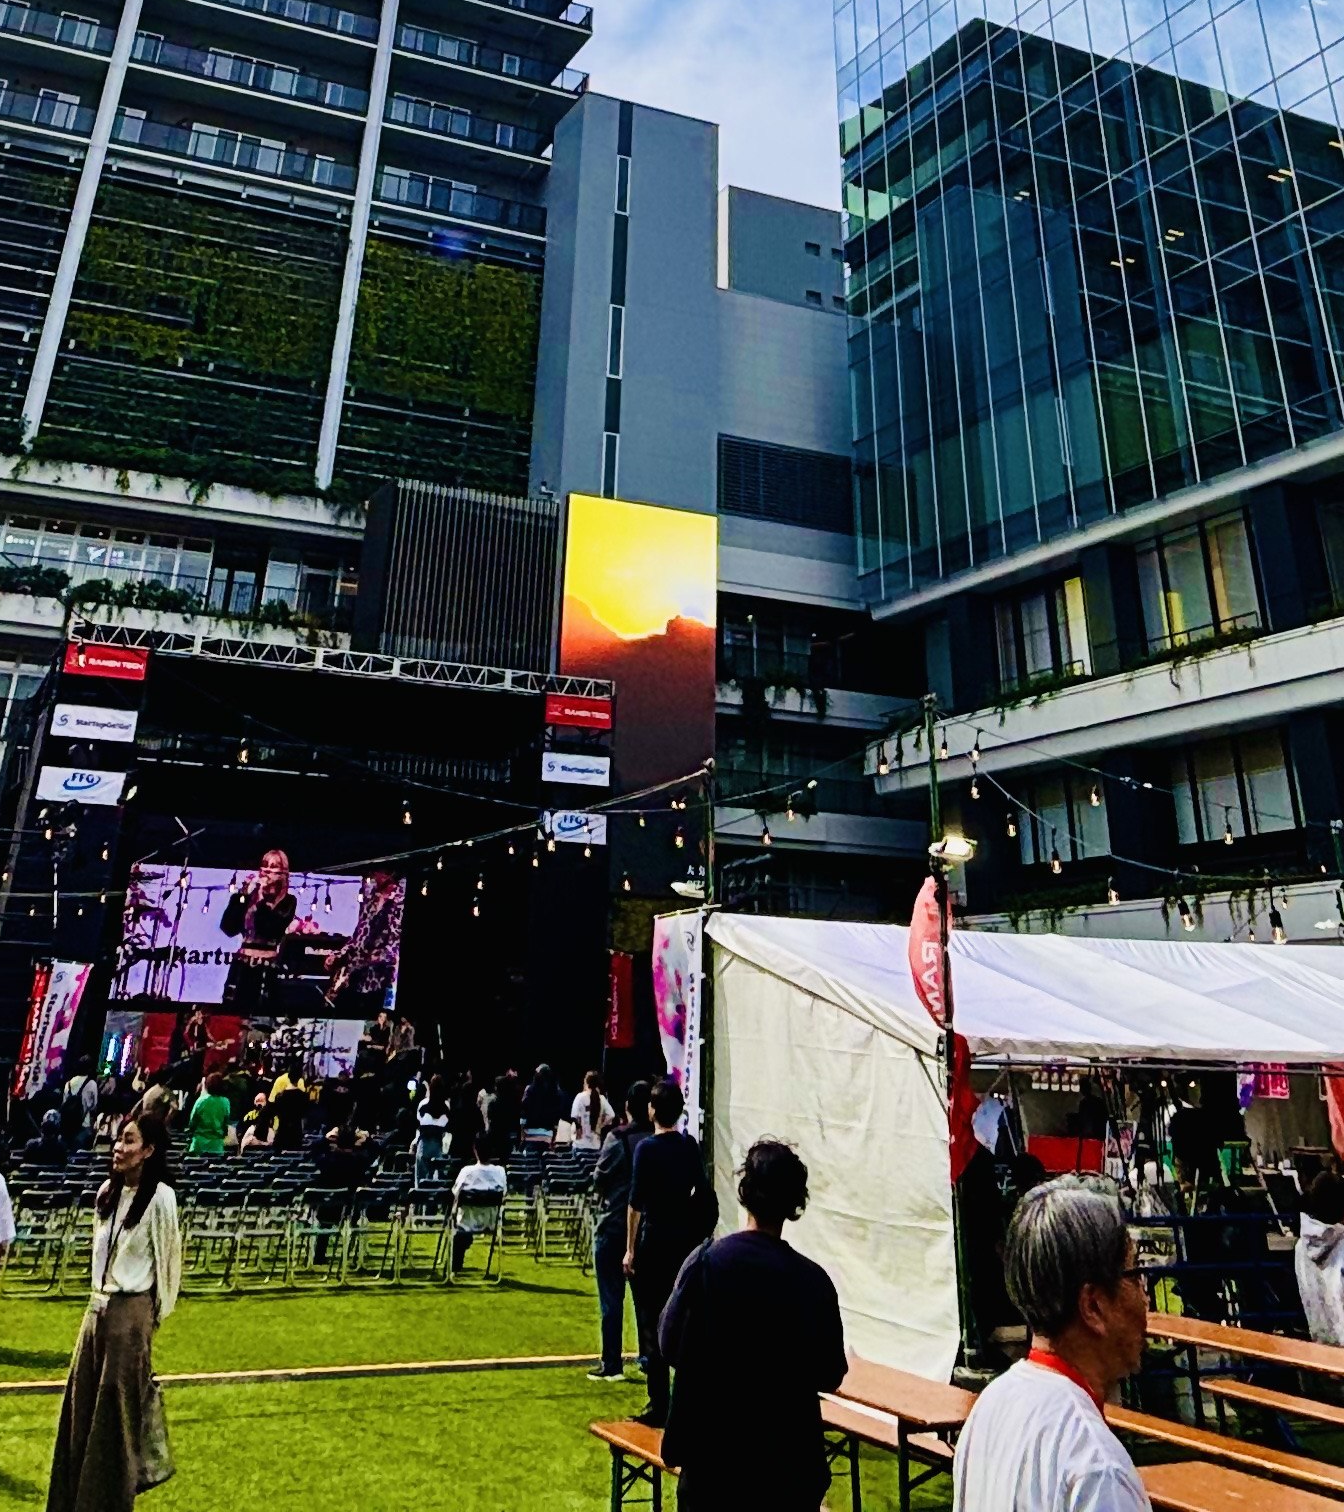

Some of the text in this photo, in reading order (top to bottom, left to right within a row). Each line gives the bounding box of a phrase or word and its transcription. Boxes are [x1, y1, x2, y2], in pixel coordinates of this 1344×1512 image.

[88, 657, 144, 670] RAMEN TECH
[71, 772, 96, 784] FFG
[563, 814, 583, 825] FFG
